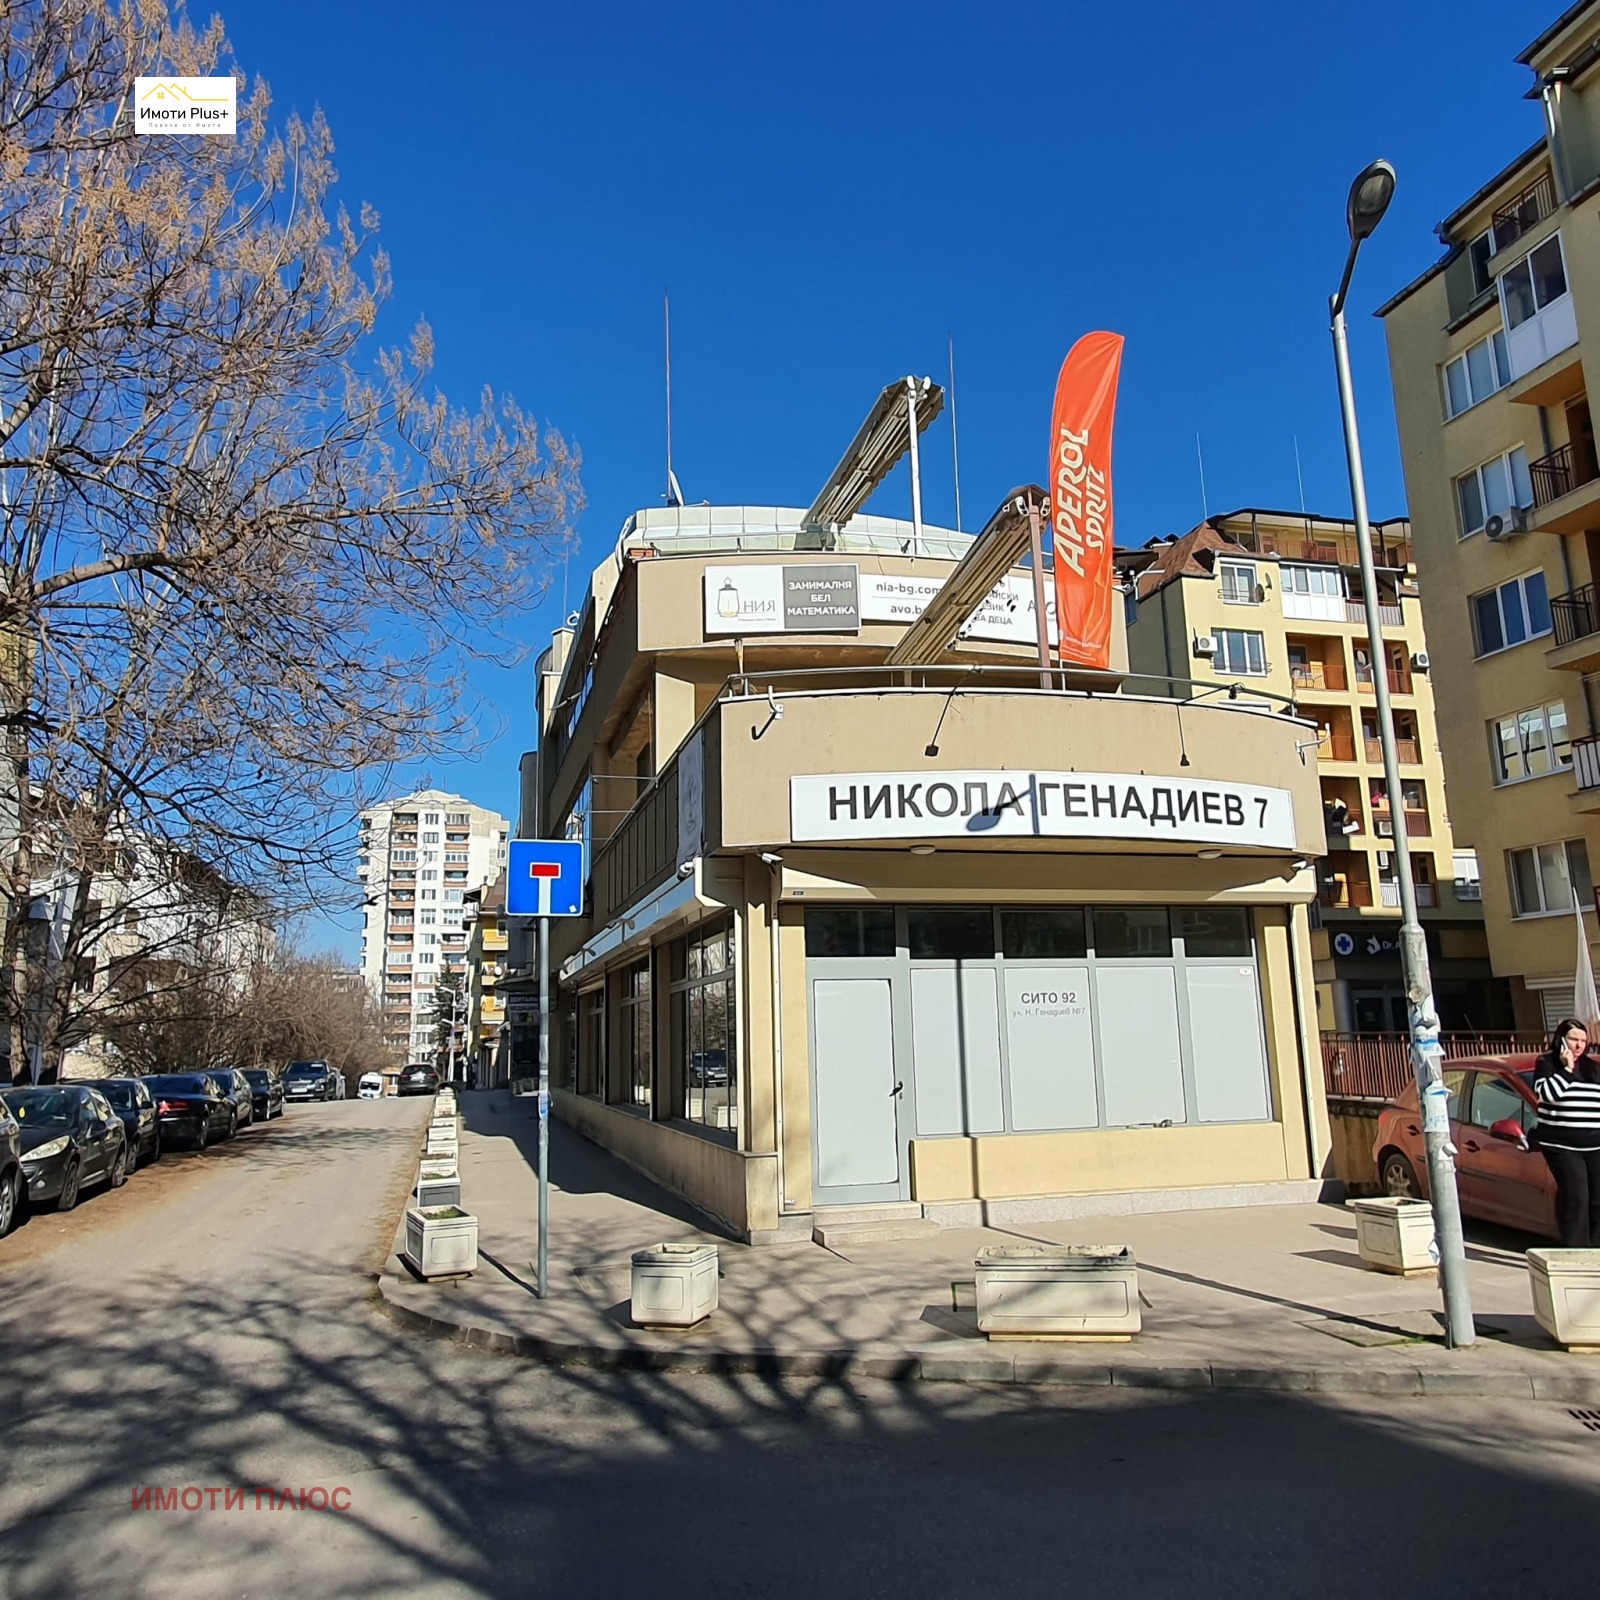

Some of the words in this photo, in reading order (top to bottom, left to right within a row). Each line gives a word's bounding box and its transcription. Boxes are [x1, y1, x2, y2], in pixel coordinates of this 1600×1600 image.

[1053, 425, 1089, 578] APEROL
[1085, 460, 1107, 555] SPRITZ
[788, 580, 852, 590] ЗАНИМАЛНЯ
[810, 594, 831, 602] БЕЛ
[743, 600, 776, 613] НИЯ
[787, 606, 856, 616] МАТЕМАТИКА
[988, 615, 1013, 625] ДЕЦА
[829, 782, 1025, 821] НИКОЛА
[1038, 782, 1246, 828] ГЕНАДИЕВ
[1253, 797, 1268, 829] 7
[1020, 992, 1058, 1004] СИТО
[1061, 992, 1077, 1004] 92
[1012, 1010, 1023, 1018] ул.
[1025, 1008, 1033, 1017] Н.
[1035, 1007, 1071, 1018] Генадиев
